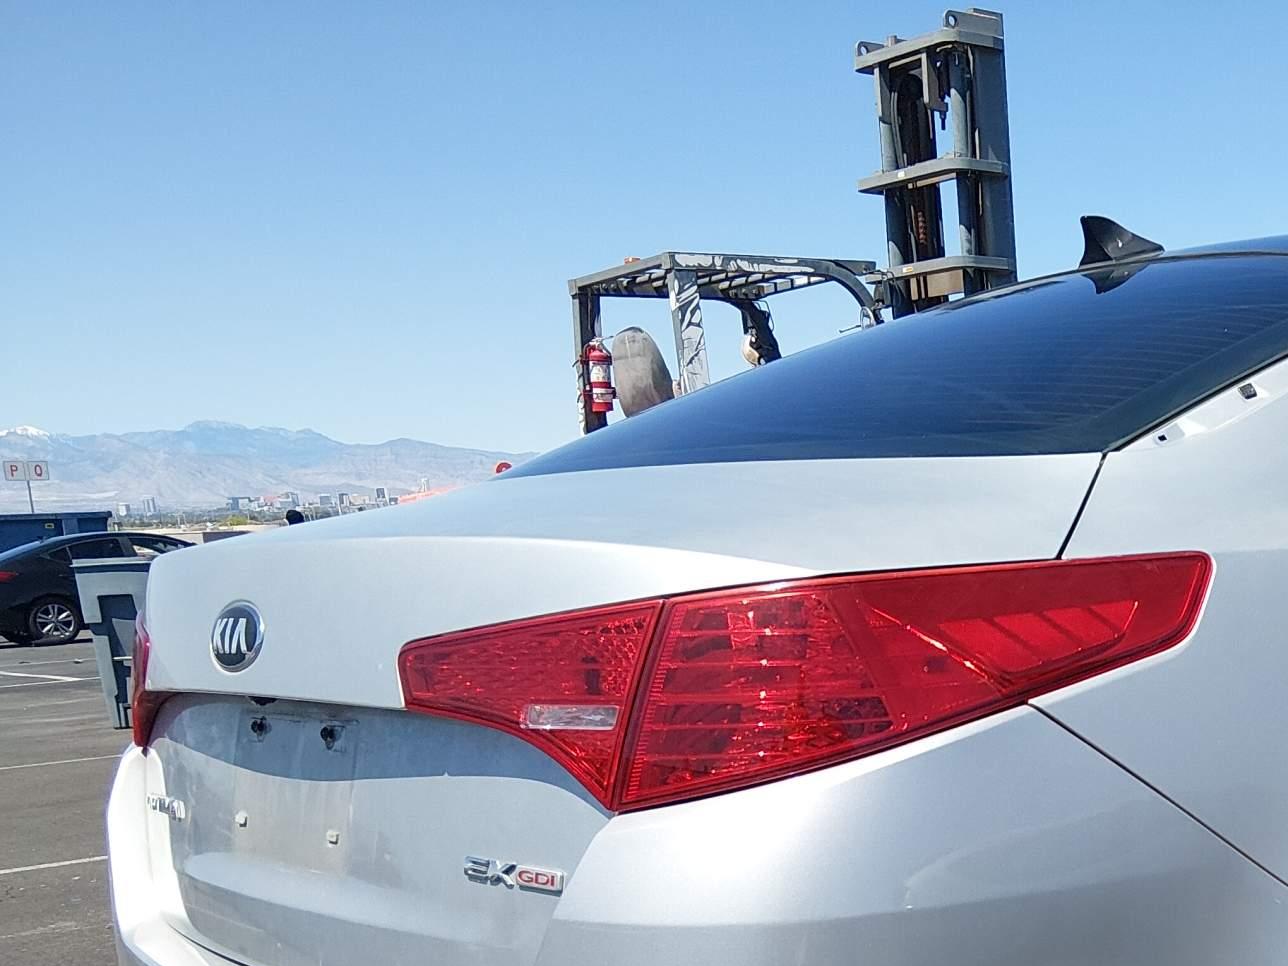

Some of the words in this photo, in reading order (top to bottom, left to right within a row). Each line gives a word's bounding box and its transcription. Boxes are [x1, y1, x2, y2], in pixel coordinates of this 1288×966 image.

[10, 464, 18, 478] P
[213, 617, 248, 654] KIA
[464, 855, 517, 889] EX
[517, 869, 556, 887] GDI
